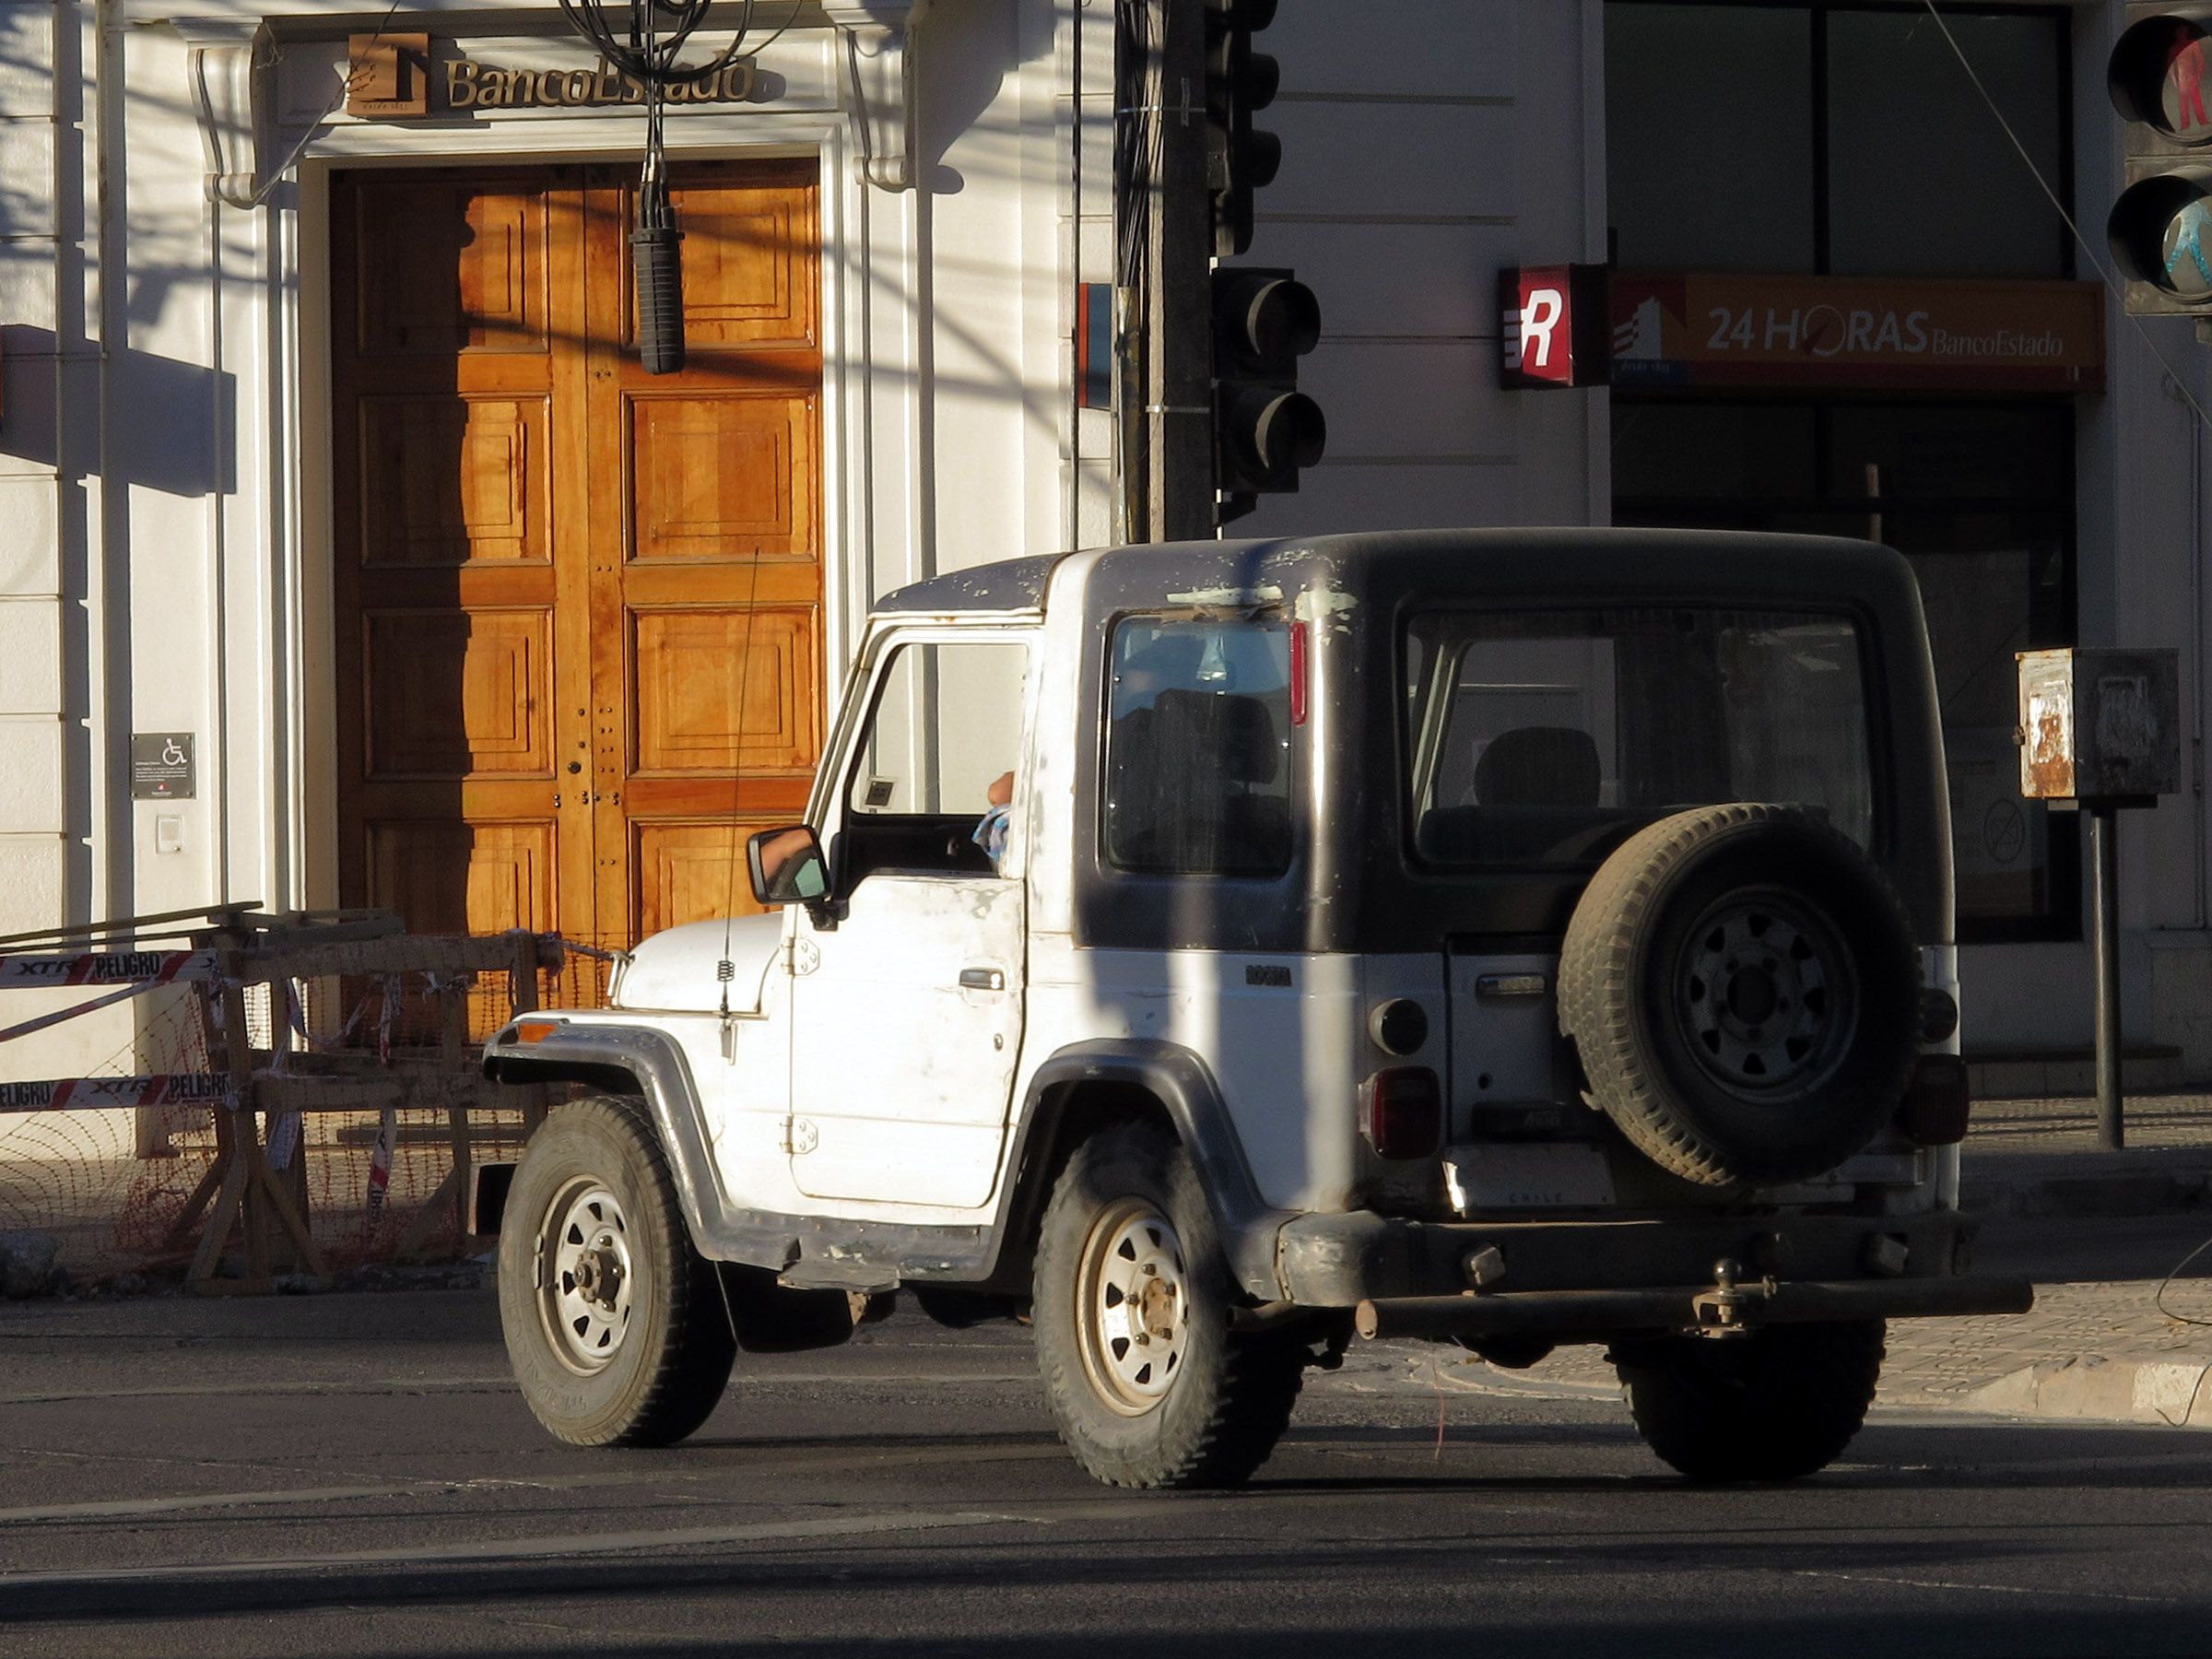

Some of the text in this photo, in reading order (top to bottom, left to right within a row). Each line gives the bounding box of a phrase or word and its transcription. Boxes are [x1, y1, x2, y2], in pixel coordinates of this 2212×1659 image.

[443, 50, 755, 107] BancoEsado
[1706, 304, 2064, 358] 24 HORAS BancoEstado
[95, 953, 160, 979] PELIGRO
